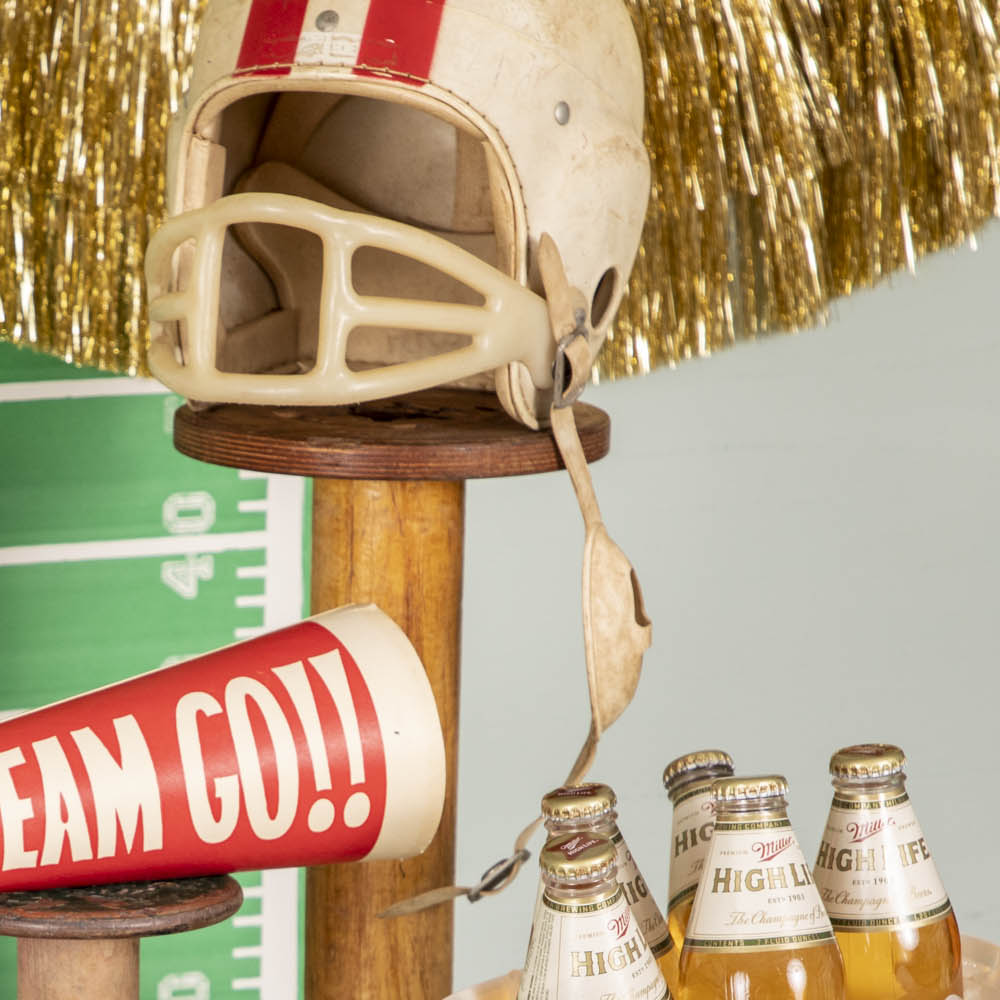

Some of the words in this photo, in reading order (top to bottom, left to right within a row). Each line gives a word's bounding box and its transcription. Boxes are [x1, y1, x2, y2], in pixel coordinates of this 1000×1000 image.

[174, 648, 371, 844] GO!!
[674, 822, 714, 858] HIG
[752, 835, 797, 864] Miller
[815, 838, 877, 872] HIGH
[711, 866, 787, 894] HIGH
[570, 936, 642, 978] HIGH
